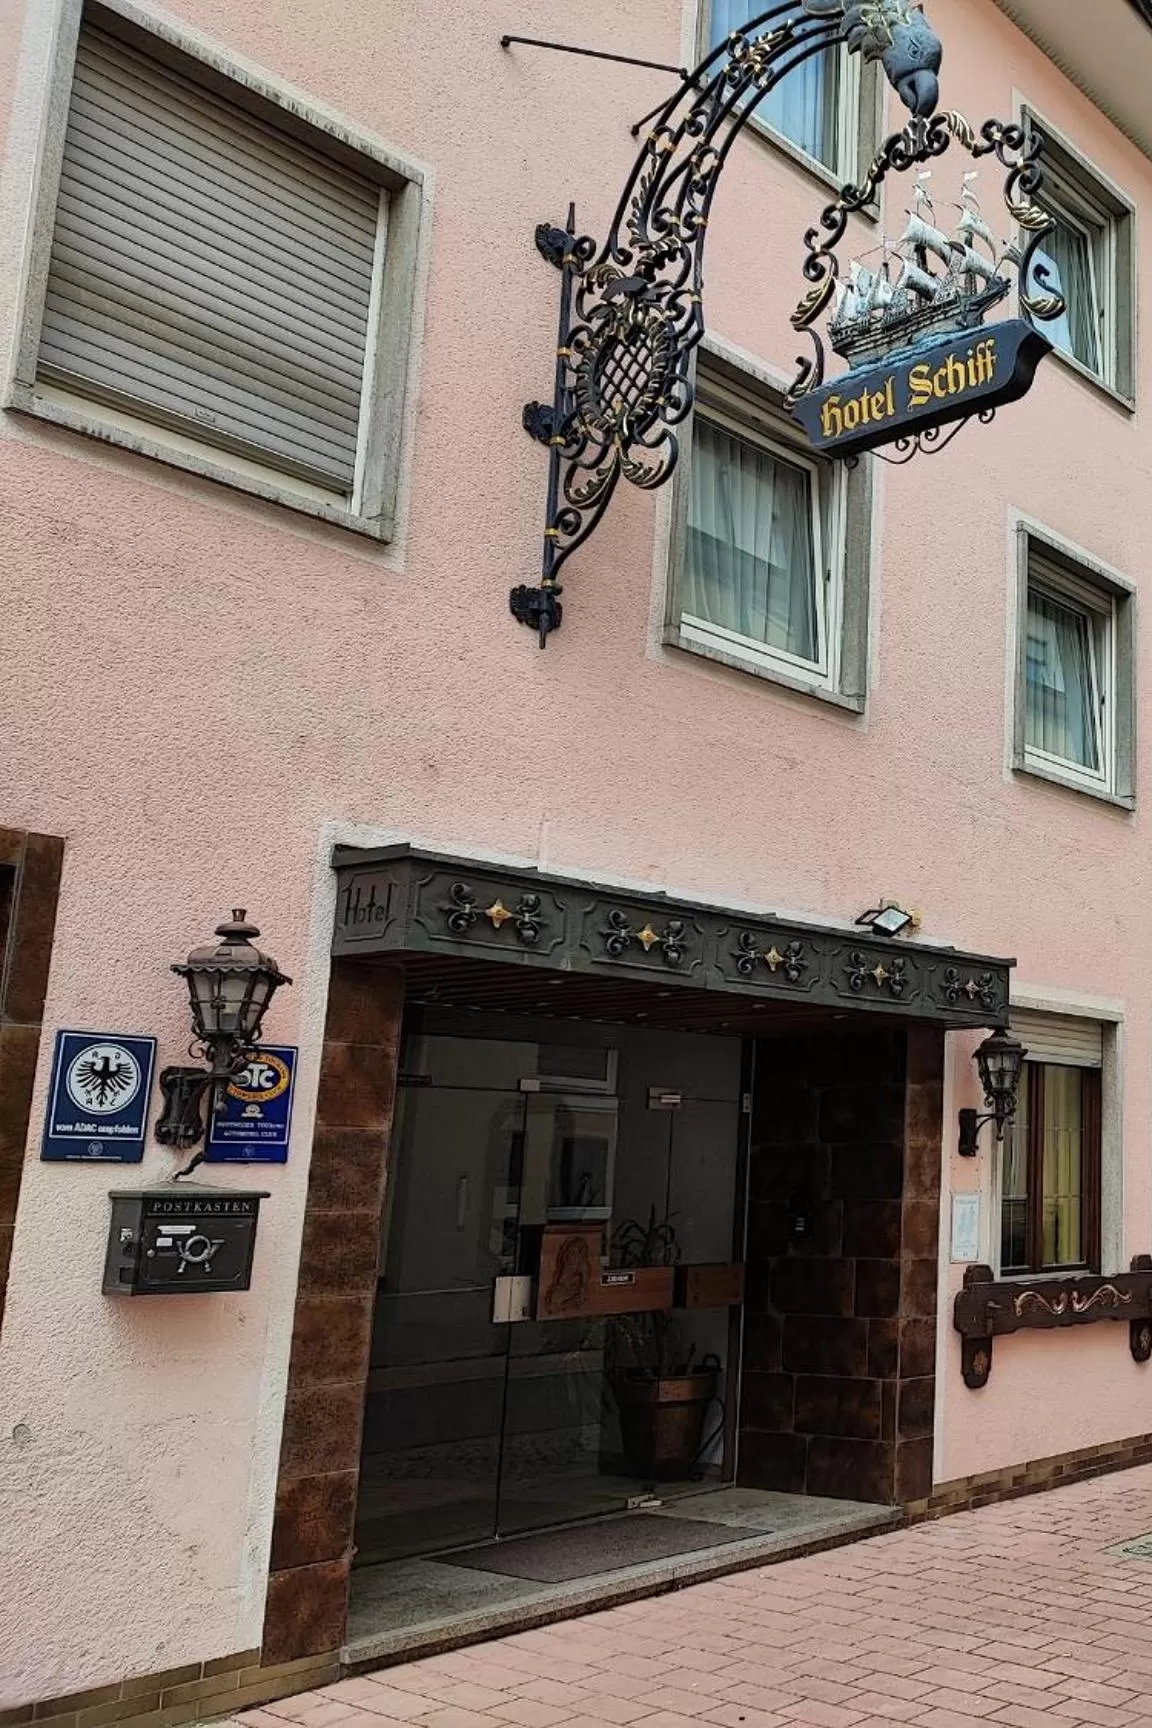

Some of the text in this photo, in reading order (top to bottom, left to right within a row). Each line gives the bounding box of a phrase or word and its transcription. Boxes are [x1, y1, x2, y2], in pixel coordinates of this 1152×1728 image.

[820, 338, 996, 437] Hotel Schiff
[341, 882, 394, 926] Hotel
[74, 1122, 97, 1134] ADAC
[97, 1124, 140, 1136] empfohlen
[152, 1201, 250, 1213] POSTKASTEN
